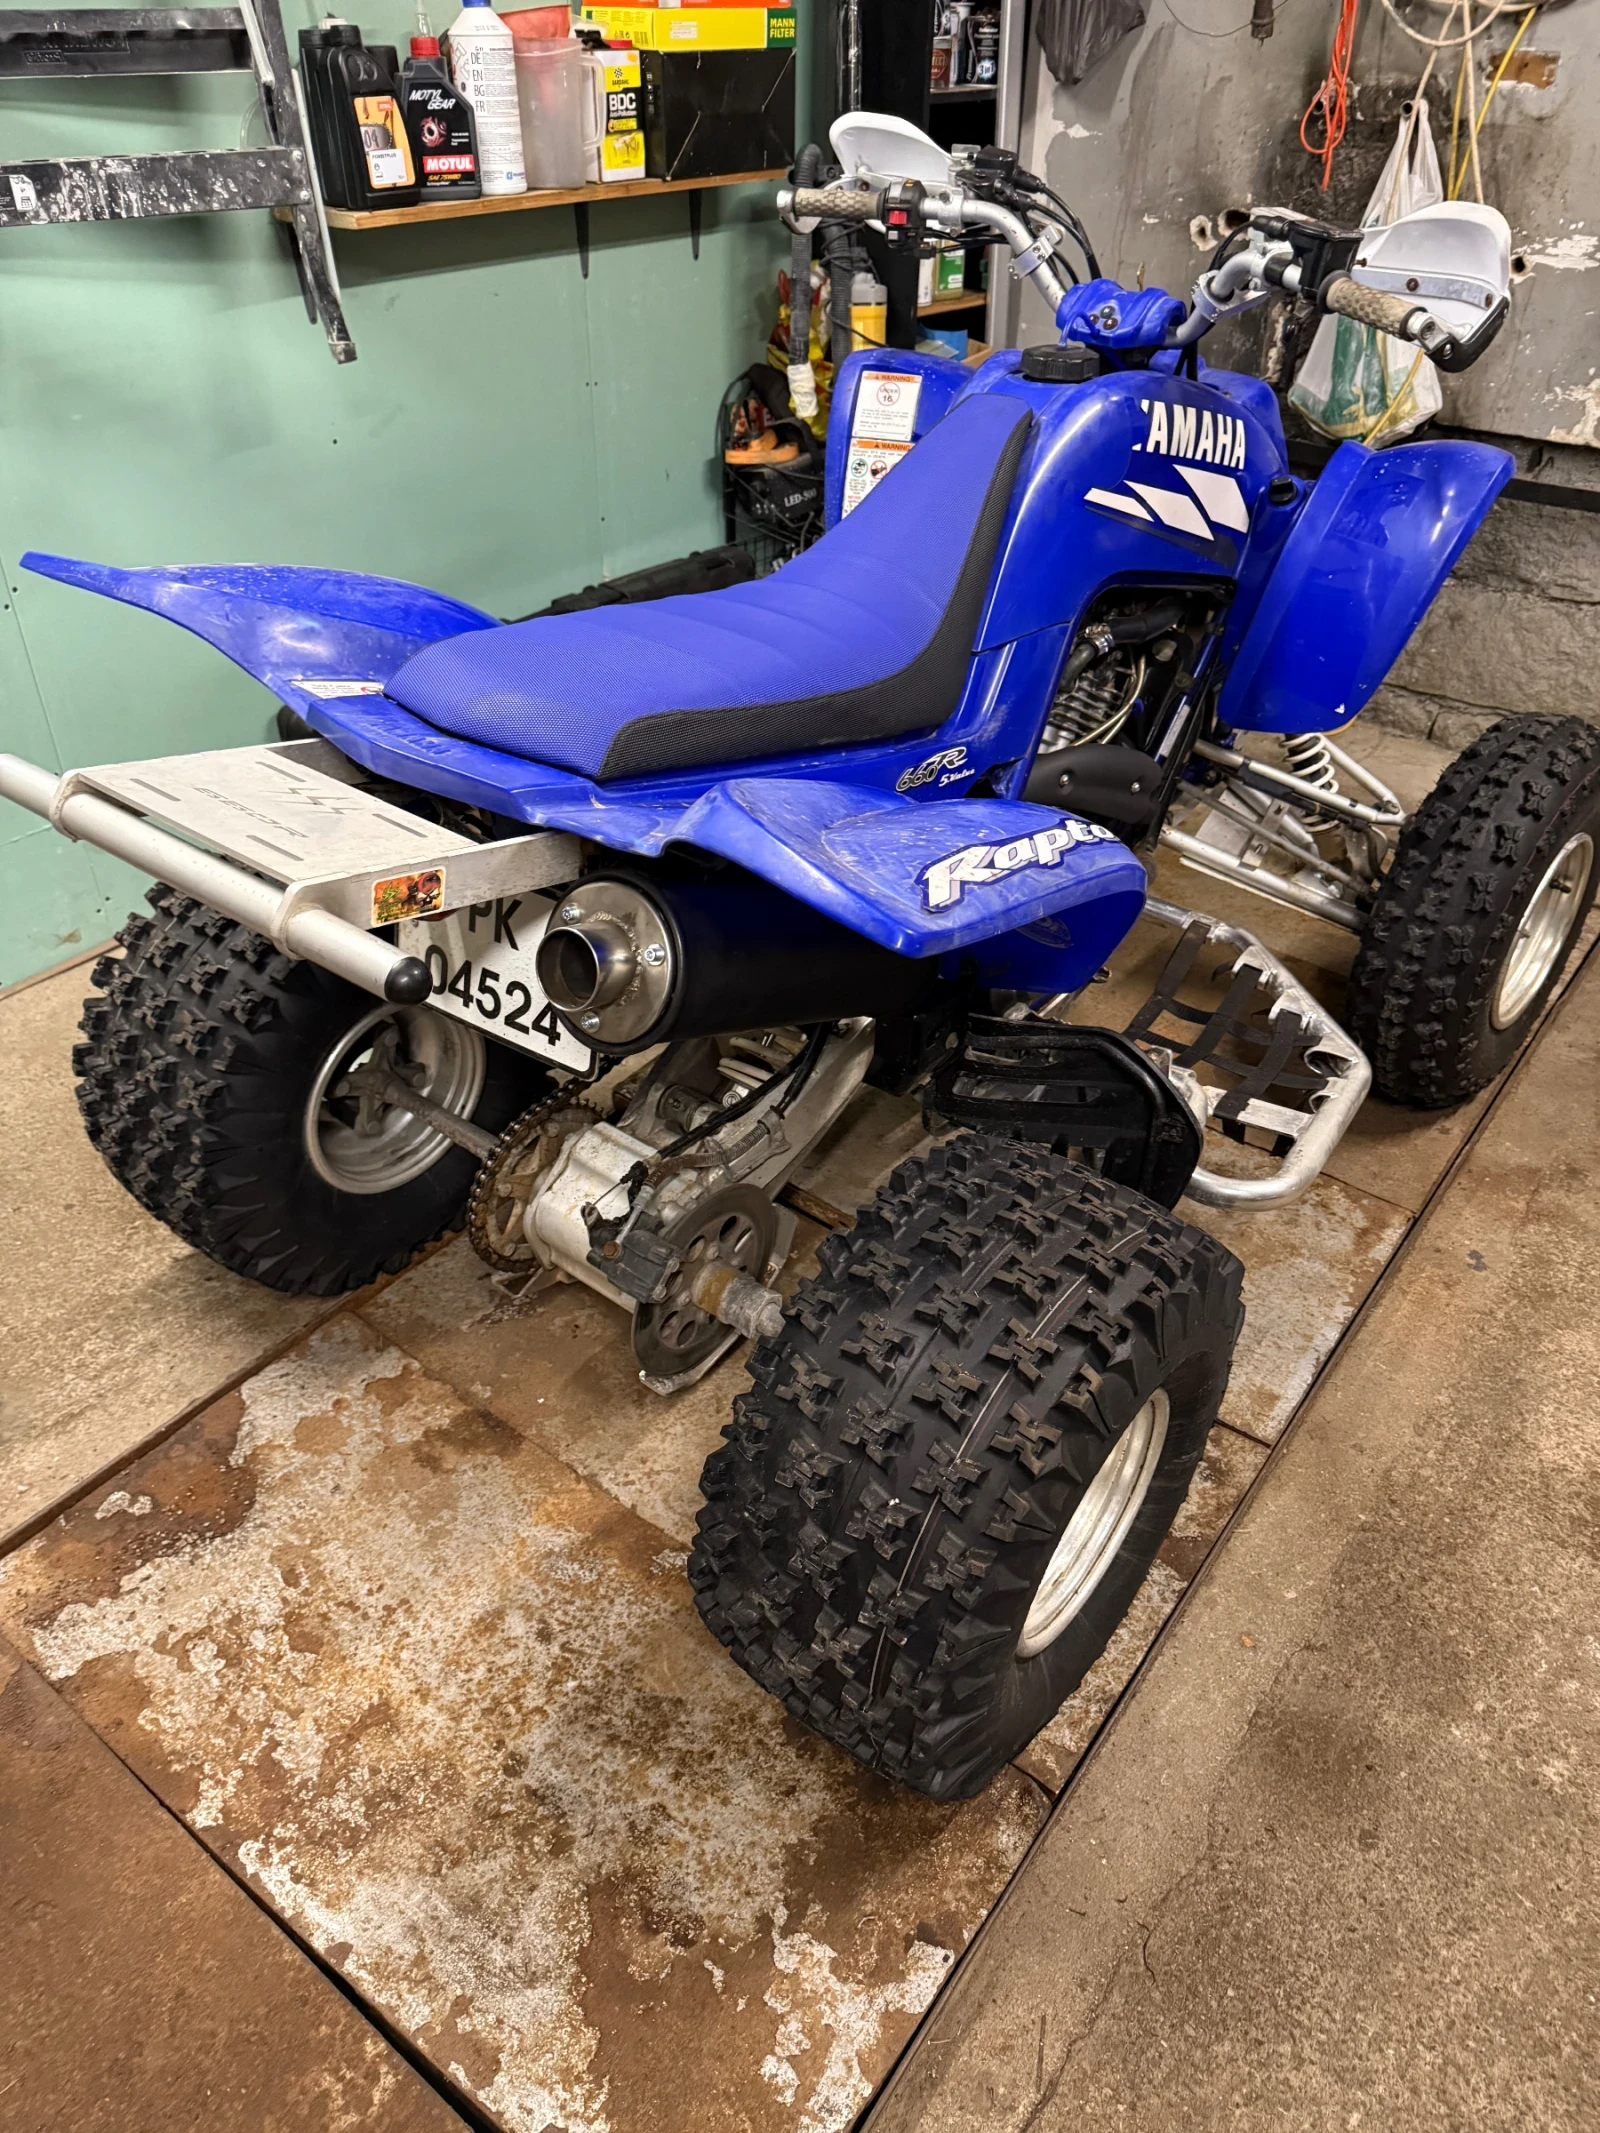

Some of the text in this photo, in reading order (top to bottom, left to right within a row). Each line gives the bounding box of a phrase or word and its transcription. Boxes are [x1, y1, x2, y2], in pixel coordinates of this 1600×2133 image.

[770, 18, 795, 28] MANN
[769, 28, 795, 39] FILTER
[471, 52, 482, 65] DE
[473, 69, 484, 82] EN
[474, 84, 485, 97] BG
[427, 98, 456, 110] GEAR
[475, 100, 486, 113] FR
[609, 93, 636, 111] BDC
[427, 157, 473, 171] MOTUL
[883, 394, 893, 403] 16
[424, 944, 561, 1046] 04524
